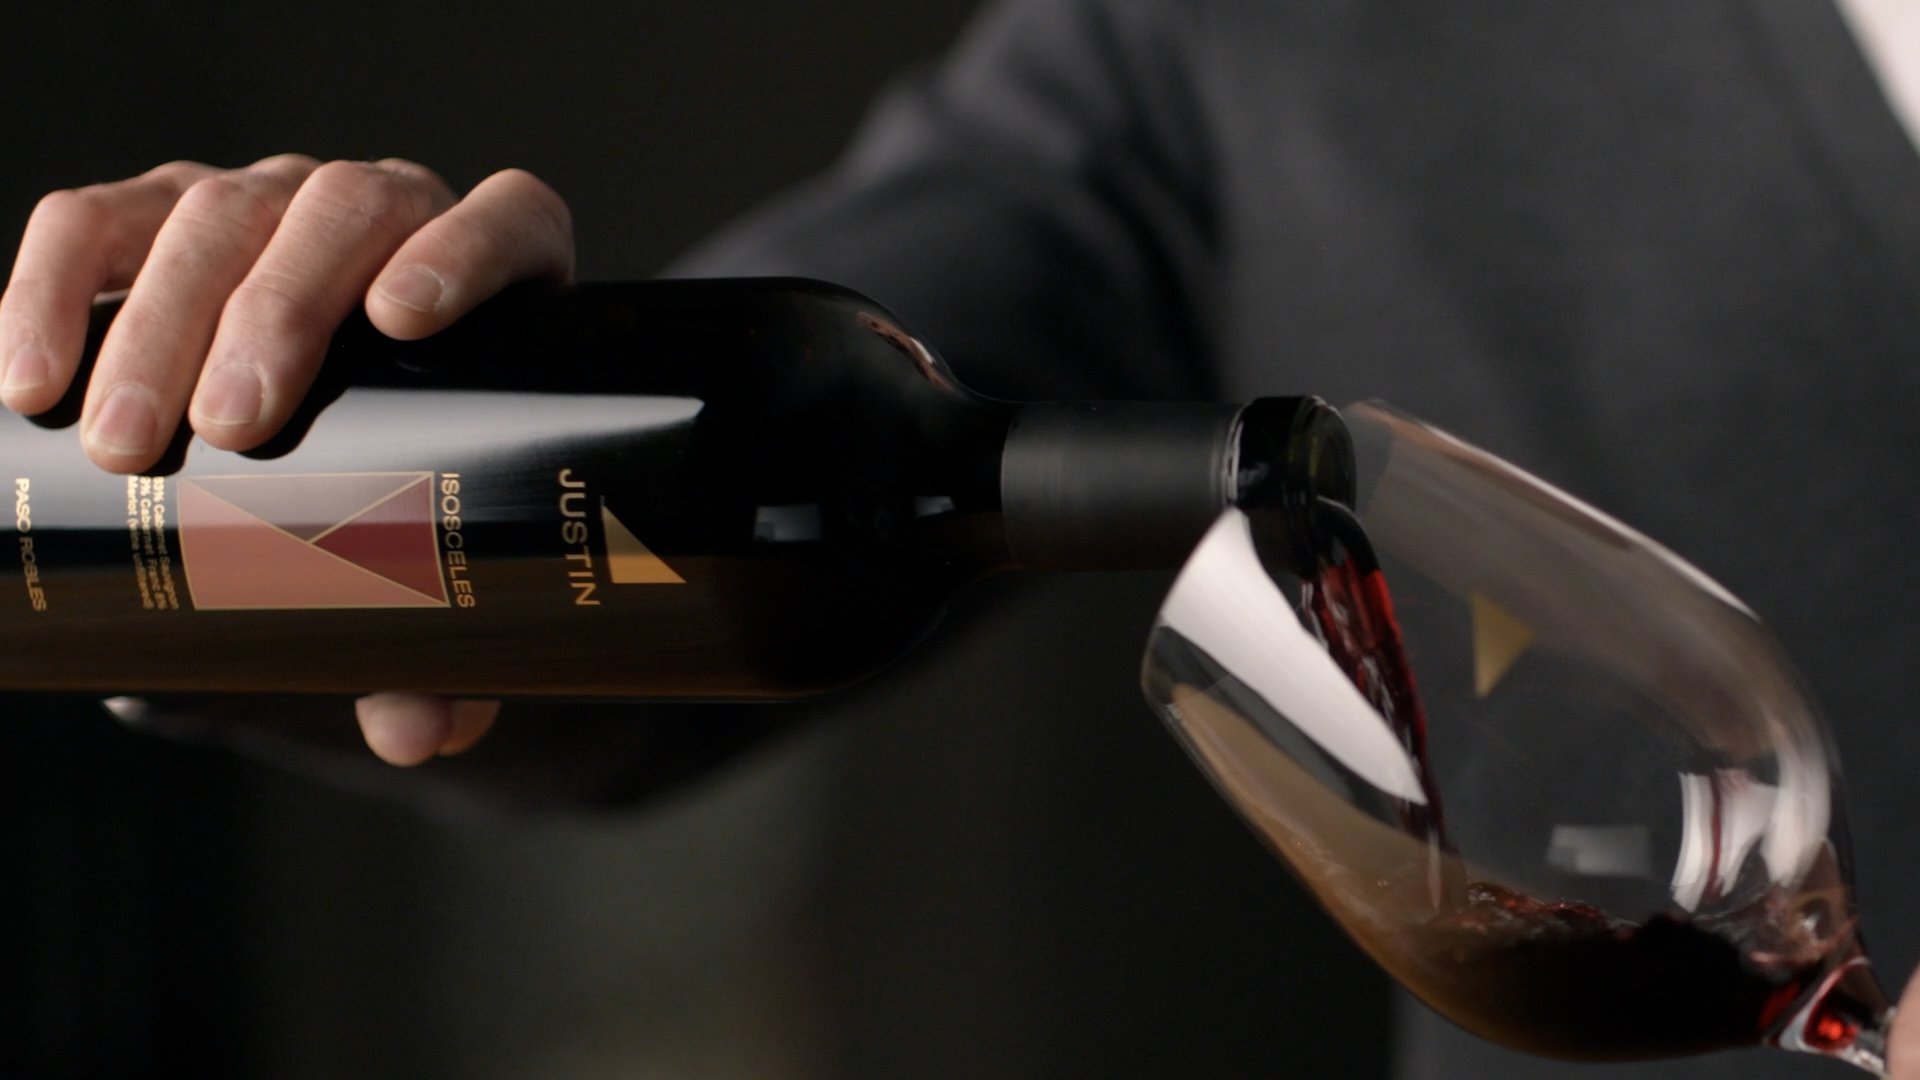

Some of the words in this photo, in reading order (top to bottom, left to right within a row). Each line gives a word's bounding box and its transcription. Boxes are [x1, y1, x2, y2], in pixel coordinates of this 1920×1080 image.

[15, 477, 31, 532] PASO
[441, 473, 475, 608] ISOSCELES
[558, 468, 600, 605] JUSTIN
[19, 536, 47, 611] ROBLES
